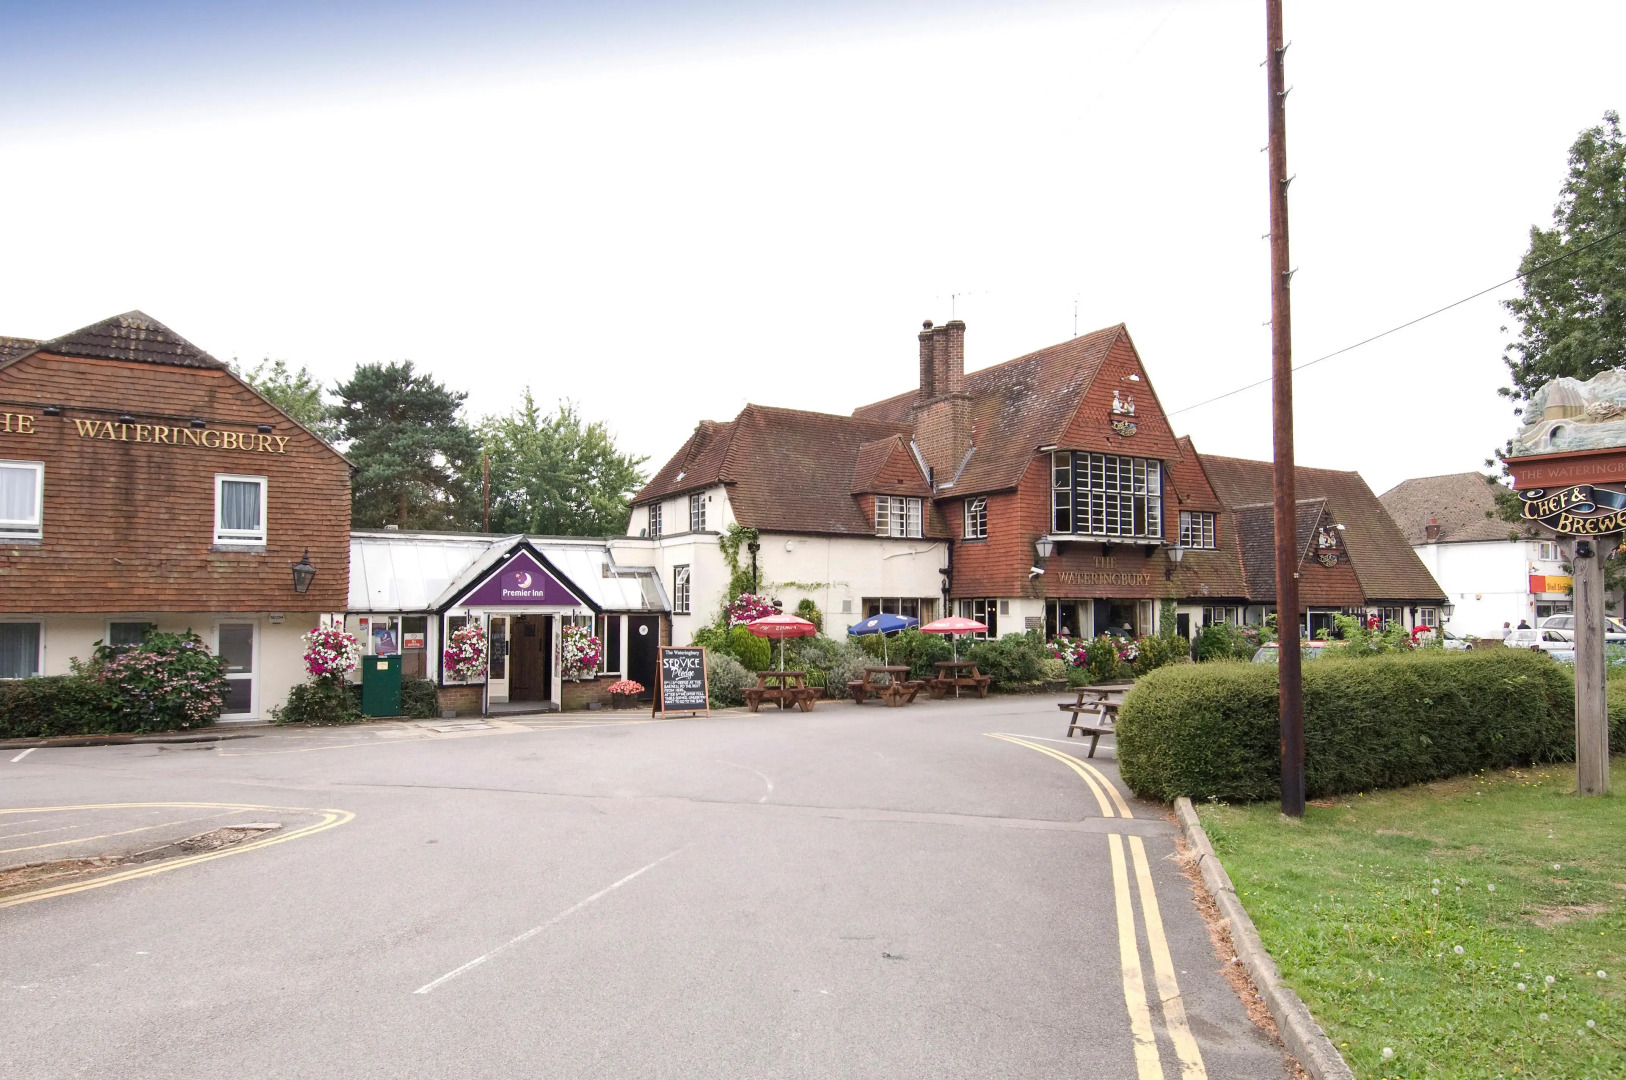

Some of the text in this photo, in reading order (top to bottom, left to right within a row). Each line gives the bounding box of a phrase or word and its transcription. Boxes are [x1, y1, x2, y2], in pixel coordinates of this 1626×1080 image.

[73, 418, 291, 454] WATERINGBURY
[1520, 463, 1626, 480] THE WATERINGB
[1524, 487, 1587, 519] CHEF &
[1093, 556, 1117, 569] THE
[1057, 571, 1151, 586] WATERINGBURY
[502, 589, 544, 597] Premier Inn
[663, 658, 699, 668] SERVICE
[671, 667, 695, 679] Pledge
